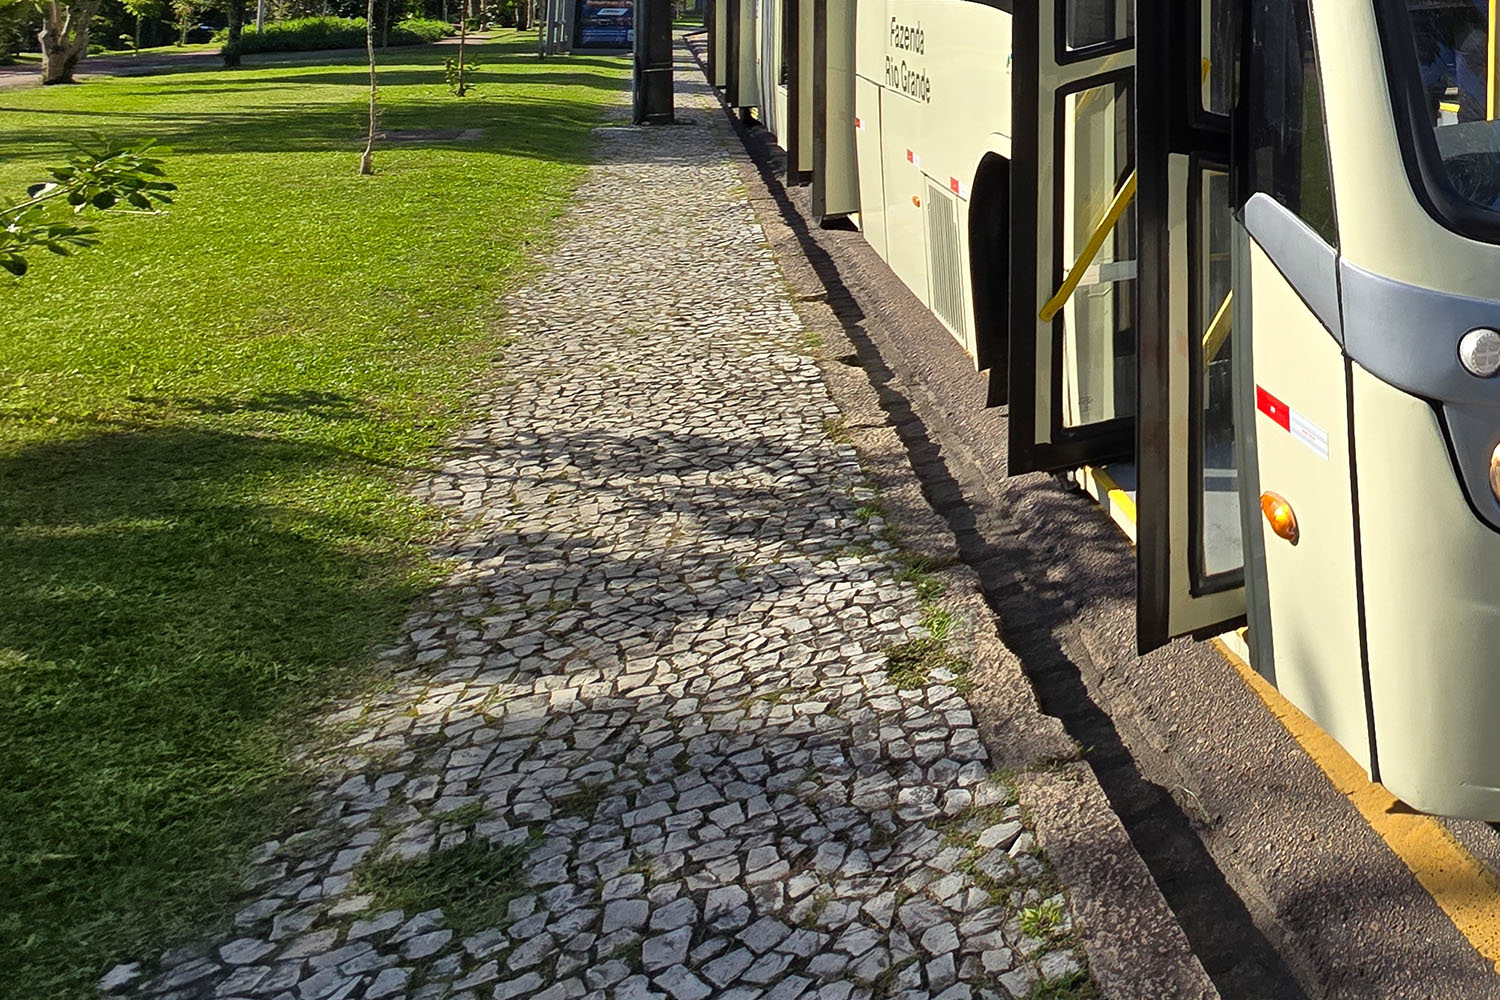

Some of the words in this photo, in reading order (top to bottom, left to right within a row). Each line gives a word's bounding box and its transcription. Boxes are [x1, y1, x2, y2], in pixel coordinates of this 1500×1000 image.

[889, 16, 925, 55] Fazenda
[885, 55, 900, 89] Rio
[900, 59, 931, 104] Grande
